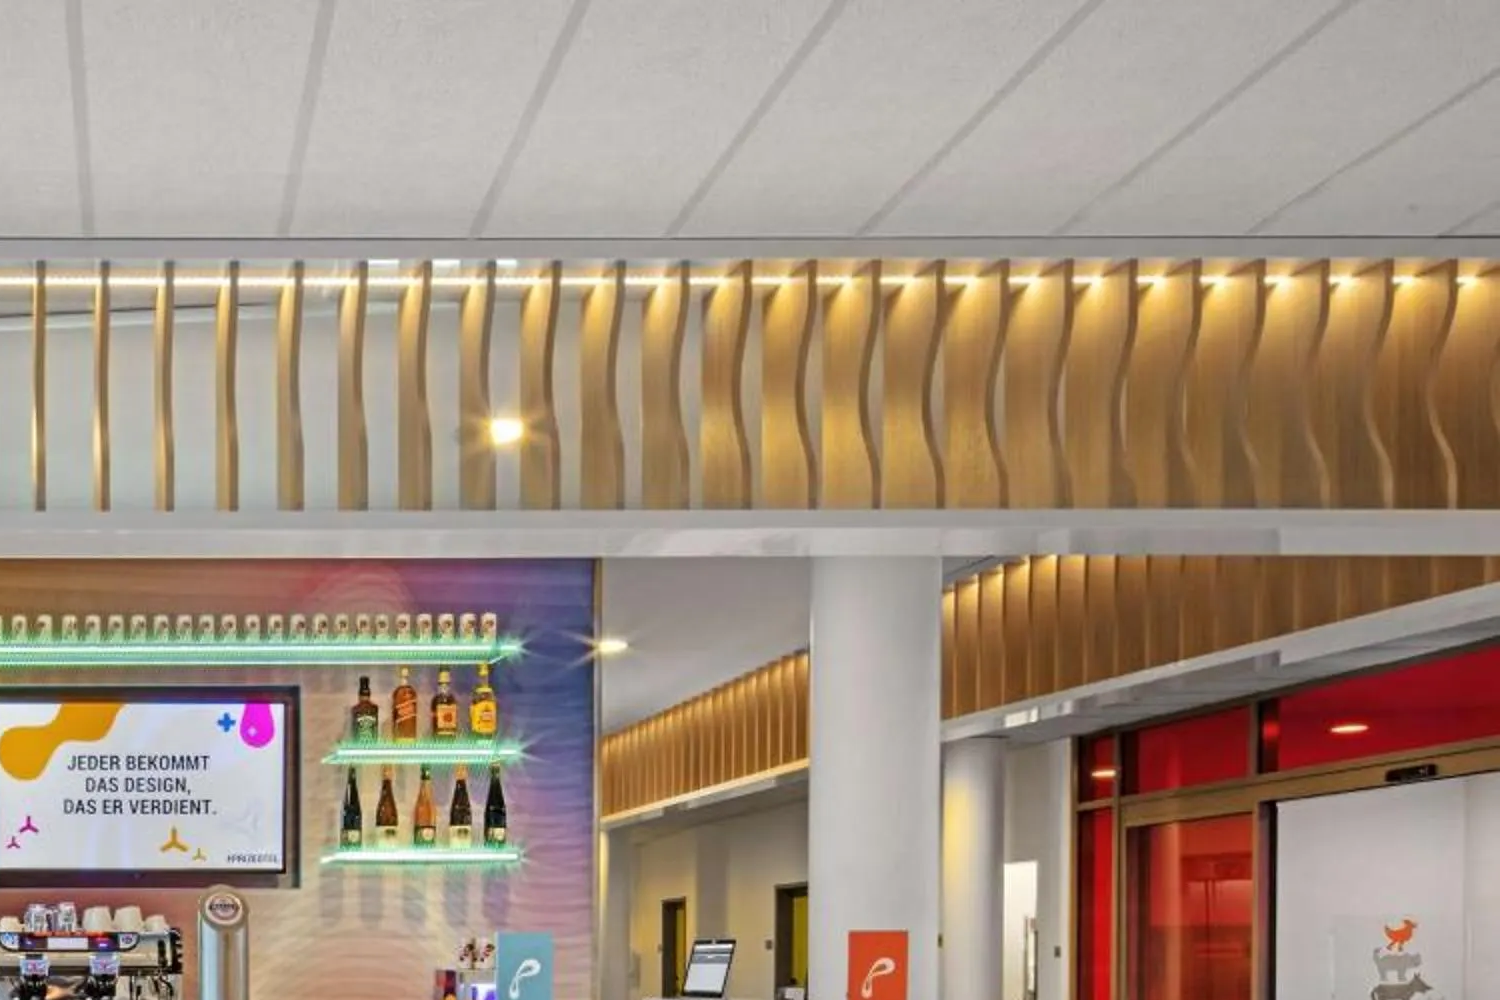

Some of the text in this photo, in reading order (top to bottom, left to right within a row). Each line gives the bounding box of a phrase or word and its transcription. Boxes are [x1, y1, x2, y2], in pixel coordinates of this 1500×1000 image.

[67, 755, 210, 771] JEDER BEKOMMT
[85, 777, 191, 795] DAS DESIGN,
[63, 799, 218, 815] DAS ER VERDIENT.
